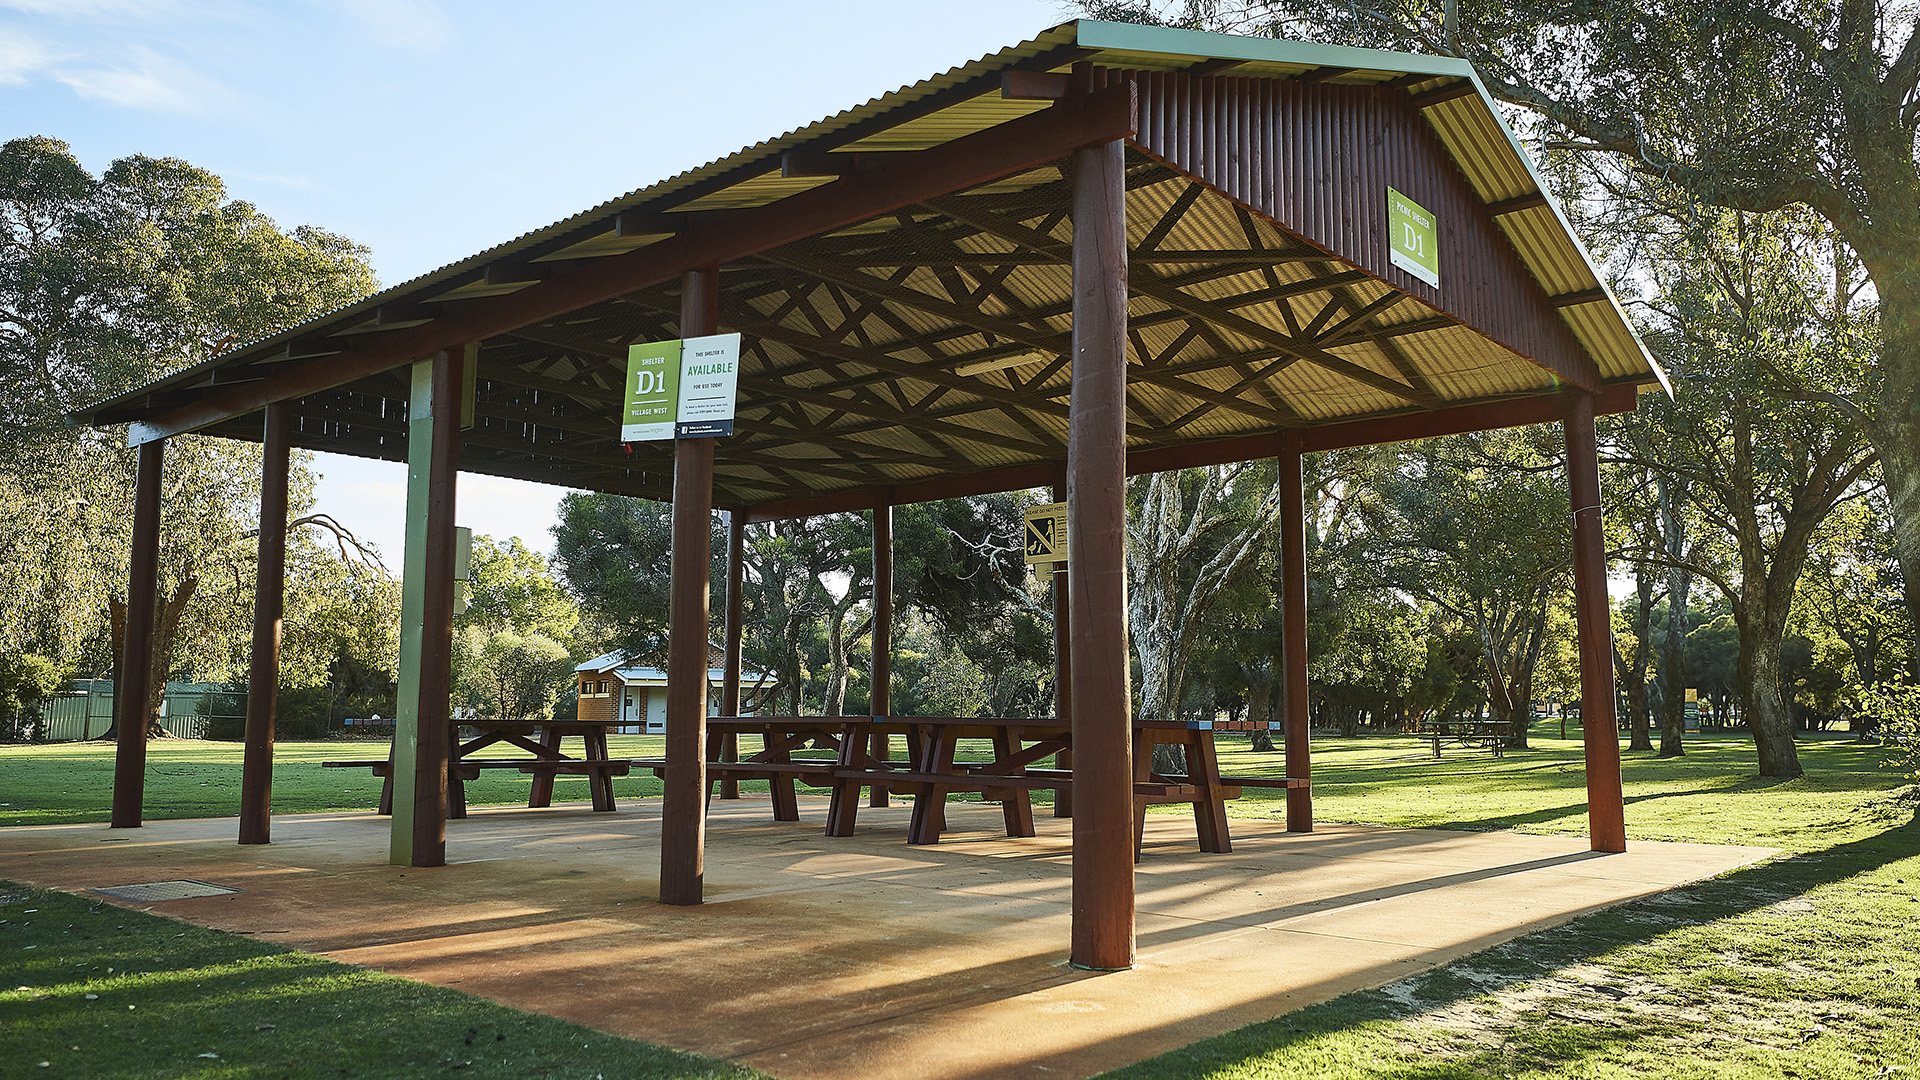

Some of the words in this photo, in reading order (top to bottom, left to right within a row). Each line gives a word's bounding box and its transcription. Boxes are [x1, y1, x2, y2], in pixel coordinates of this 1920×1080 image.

[1396, 201, 1412, 218] PICNIC
[1412, 211, 1430, 230] SHELTER
[1403, 221, 1425, 259] D1
[641, 356, 665, 366] SHELTER
[687, 362, 733, 377] AVAILABLE
[635, 370, 666, 396] D1
[631, 407, 652, 416] VILLAGE
[653, 406, 668, 415] WEST
